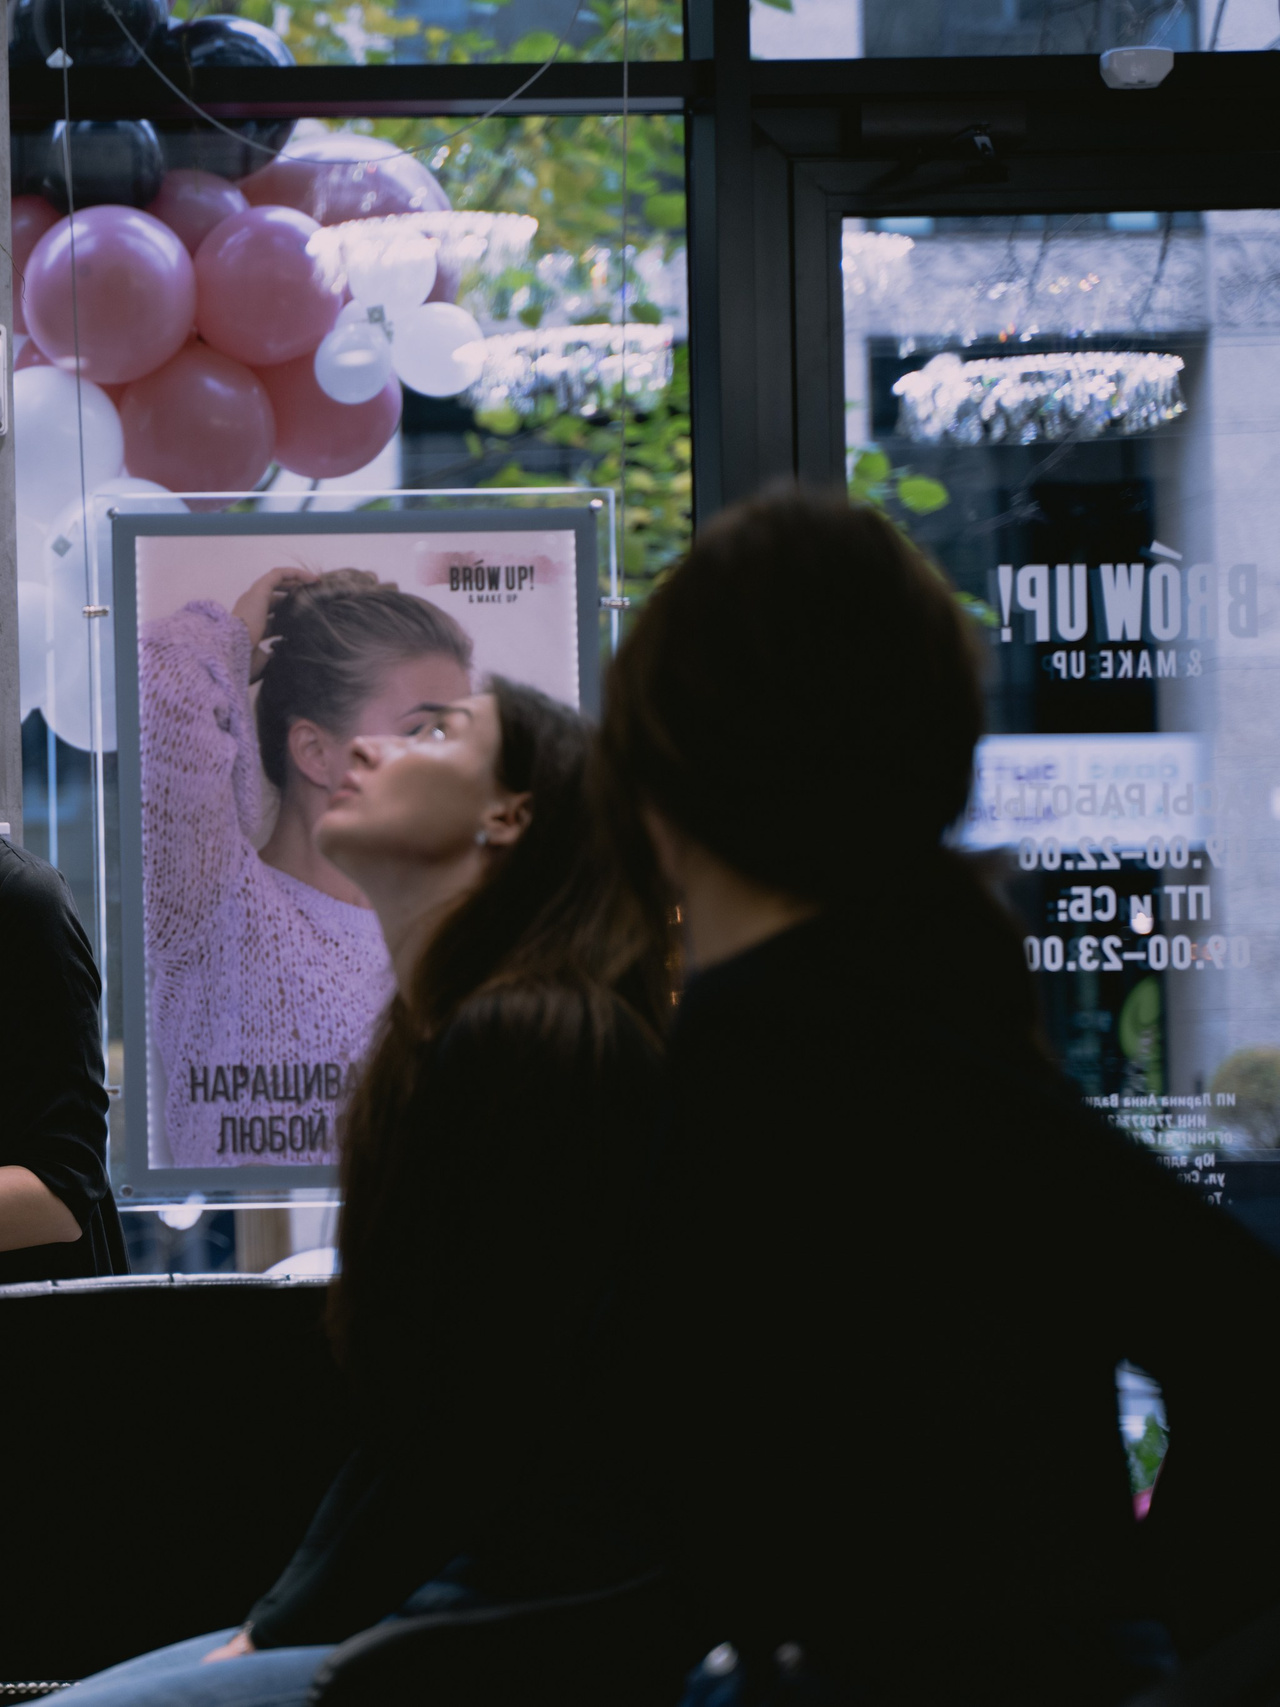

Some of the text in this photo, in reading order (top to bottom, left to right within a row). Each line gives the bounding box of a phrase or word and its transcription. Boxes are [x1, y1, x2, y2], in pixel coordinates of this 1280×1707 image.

[449, 559, 534, 591] BRÓW UP!
[477, 593, 502, 604] MAKE
[506, 593, 518, 603] UP
[217, 1107, 327, 1155] ЛЮБОЙ
